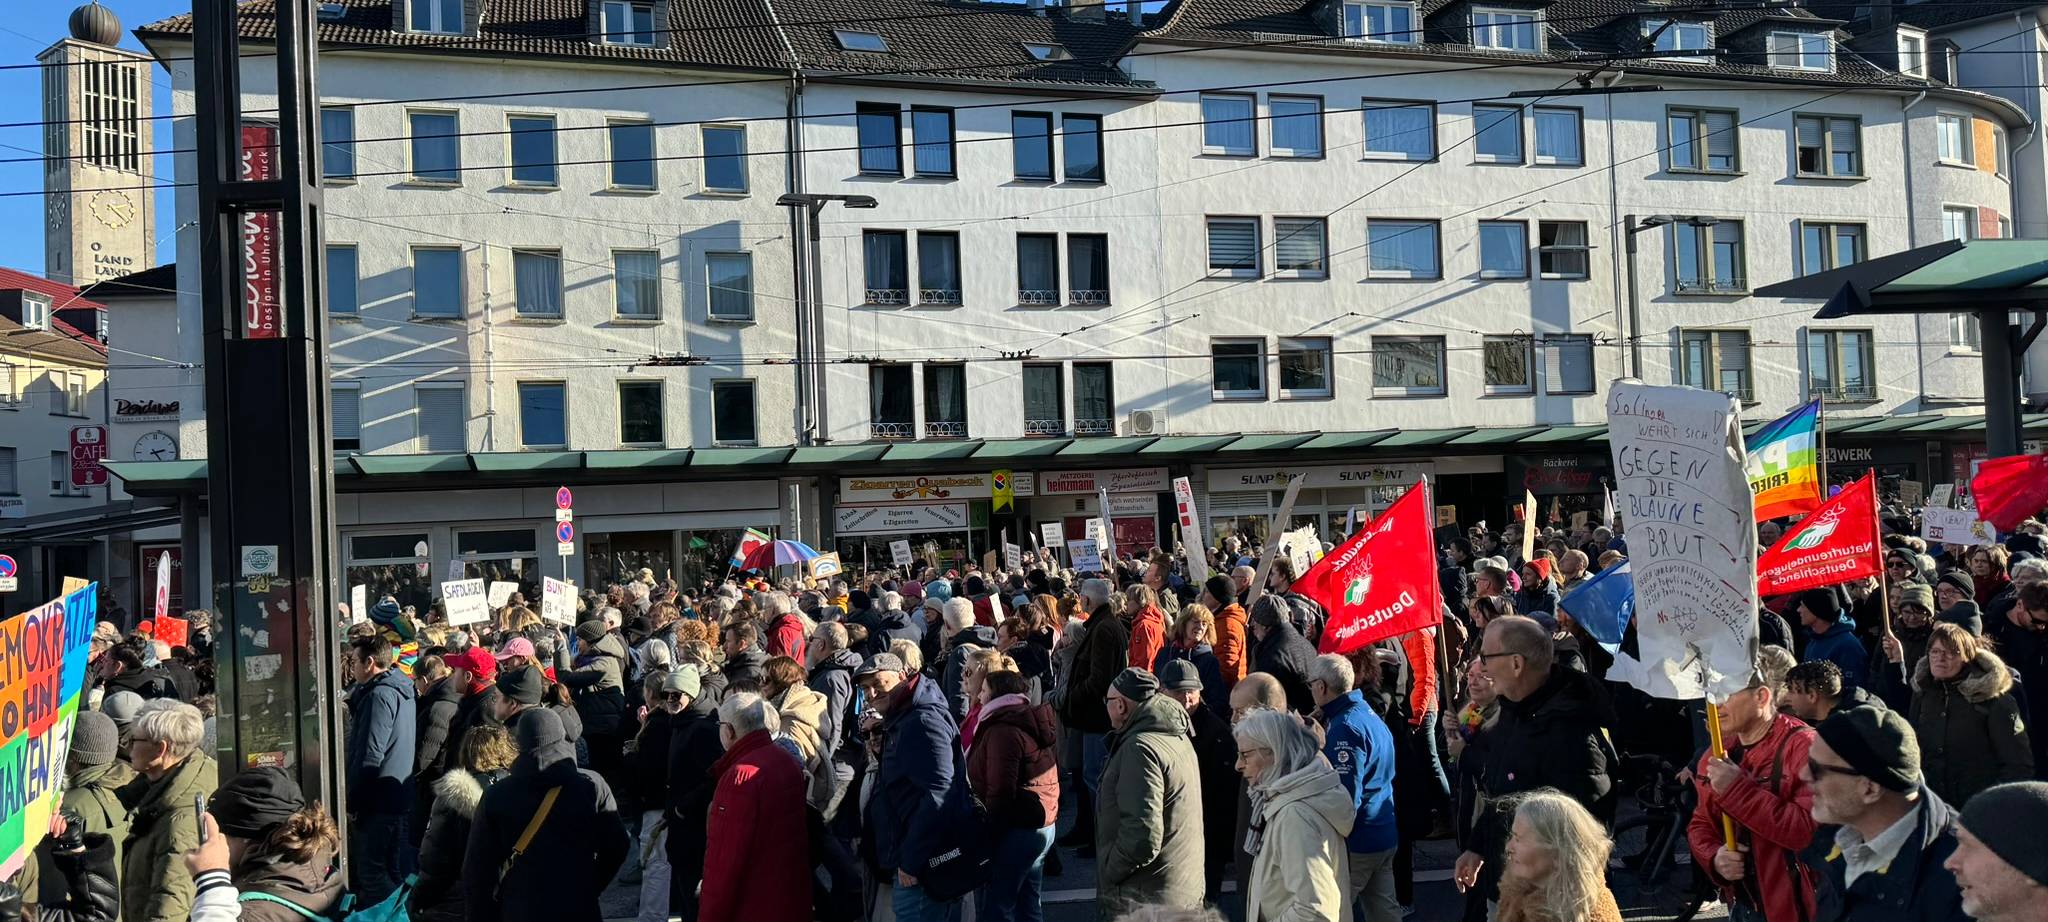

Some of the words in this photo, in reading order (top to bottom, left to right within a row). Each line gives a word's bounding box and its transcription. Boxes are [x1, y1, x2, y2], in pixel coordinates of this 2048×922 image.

[261, 227, 271, 263] Uhren
[95, 254, 133, 265] LAND
[95, 265, 132, 277] LAND
[262, 269, 271, 281] in
[262, 287, 273, 330] Design
[1638, 423, 1677, 439] WEHRT
[1619, 445, 1710, 480] GEGEN
[1648, 478, 1676, 496] DIE
[840, 508, 857, 521] Tabak
[1628, 494, 1704, 525] BLAUNE
[1645, 526, 1704, 564] BRUT
[2, 663, 65, 739] OHNE
